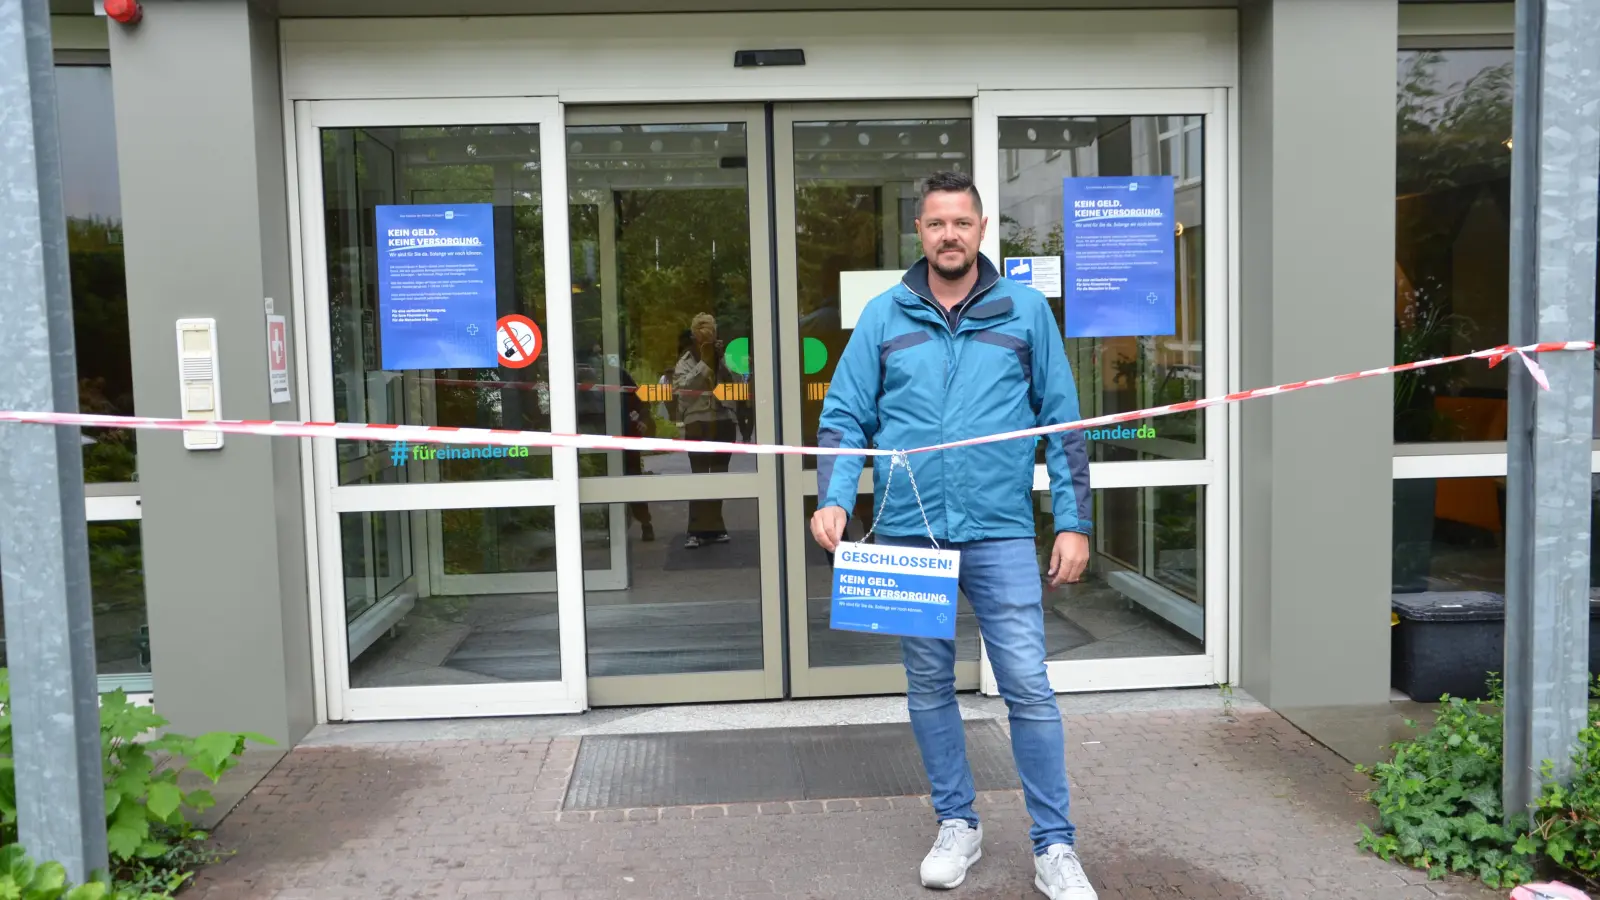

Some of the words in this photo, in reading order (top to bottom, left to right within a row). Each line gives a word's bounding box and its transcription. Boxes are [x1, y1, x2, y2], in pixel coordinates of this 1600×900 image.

[1074, 200, 1095, 208] KEIN
[1097, 199, 1122, 208] GELD.
[1075, 209, 1101, 217] KEINE
[1102, 208, 1163, 217] VERSORGUNG.
[388, 229, 410, 237] KEIN
[411, 228, 438, 236] GELD.
[388, 238, 416, 247] KEINE
[417, 237, 482, 246] VERSORGUNG.
[841, 550, 953, 570] GESCHLOSSEN!
[840, 574, 865, 585] KEIN
[867, 577, 898, 588] GELD.
[839, 585, 871, 597] KEINE
[873, 588, 950, 603] VERSORGUNG.
